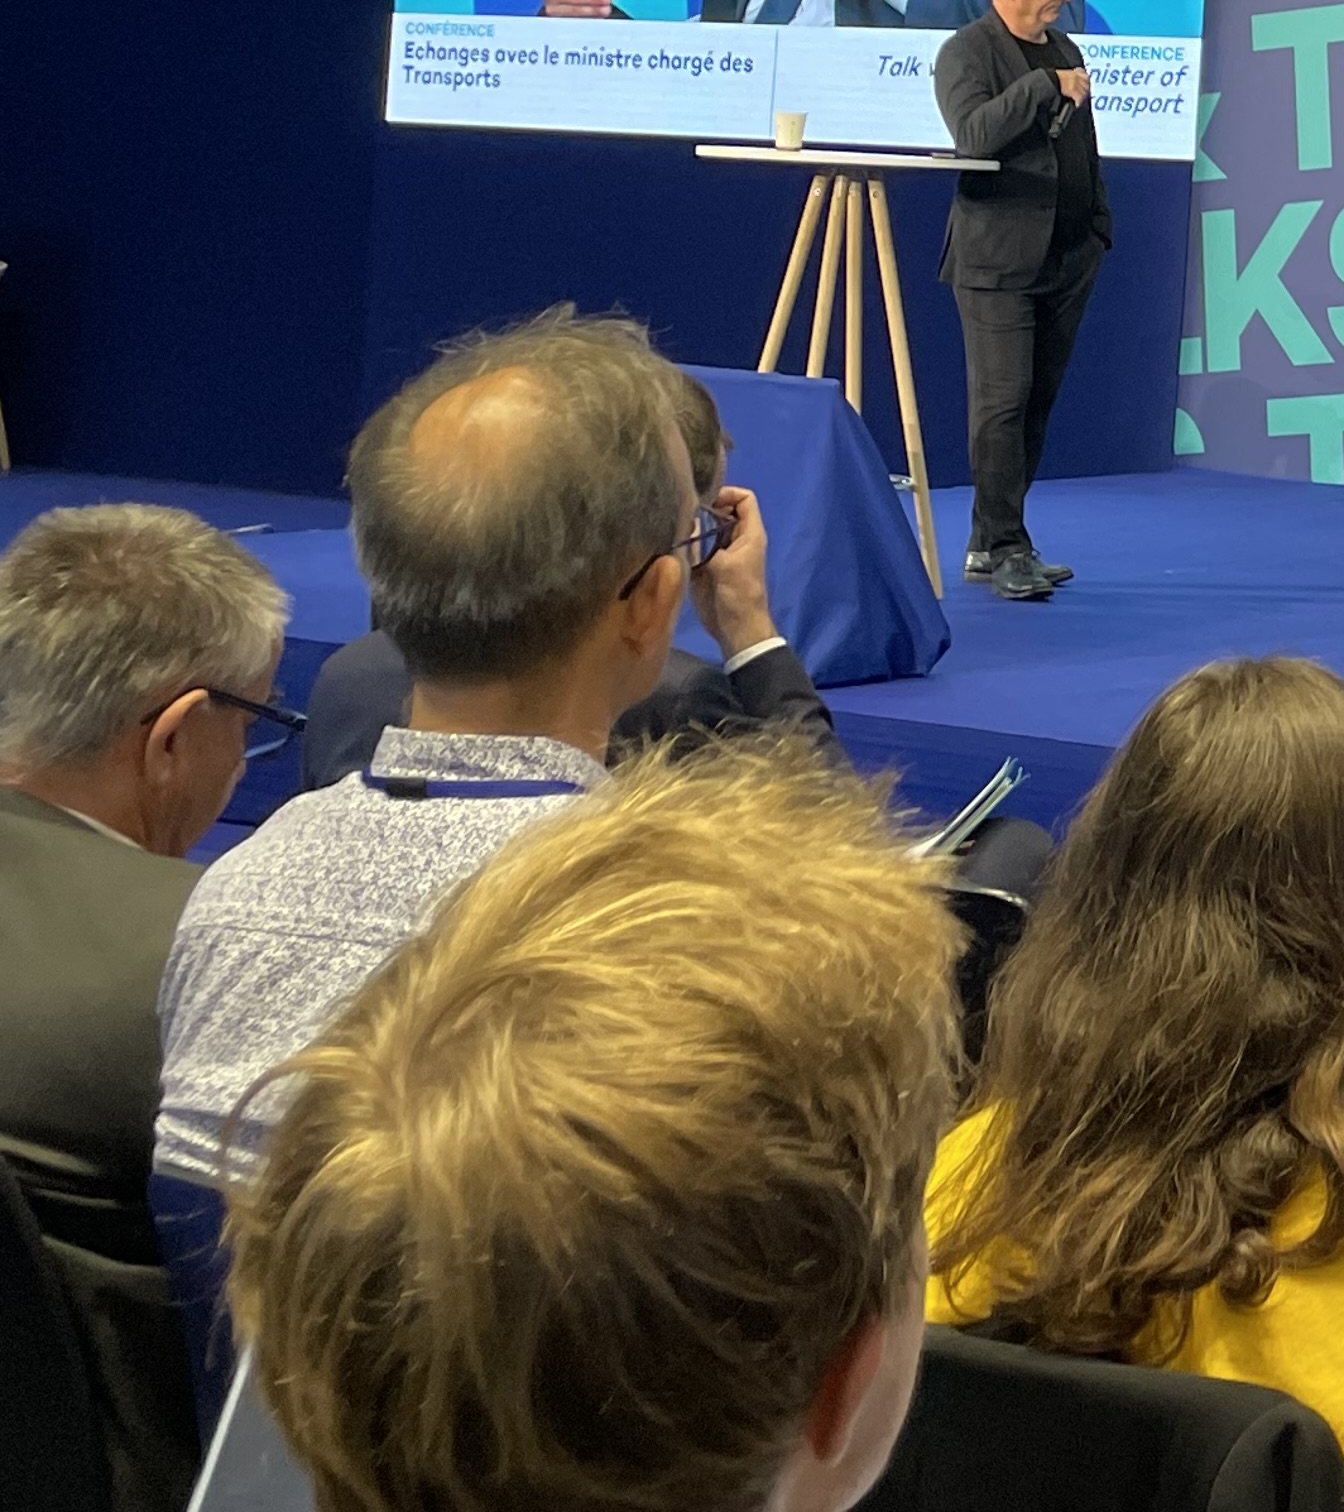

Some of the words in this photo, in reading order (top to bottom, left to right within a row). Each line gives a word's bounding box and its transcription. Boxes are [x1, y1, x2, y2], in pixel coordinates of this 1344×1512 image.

[405, 20, 495, 37] CONFÉRENCE
[404, 41, 489, 67] Echanges
[495, 48, 538, 64] avec
[543, 45, 559, 65] le
[565, 46, 642, 69] ministre
[648, 48, 714, 76] chargé
[720, 51, 753, 72] des
[1081, 44, 1185, 61] ONFERENCE
[403, 65, 501, 91] Transports
[879, 55, 922, 76] Talk
[1086, 62, 1155, 85] nister
[1160, 65, 1189, 87] of
[1090, 93, 1184, 118] ansport
